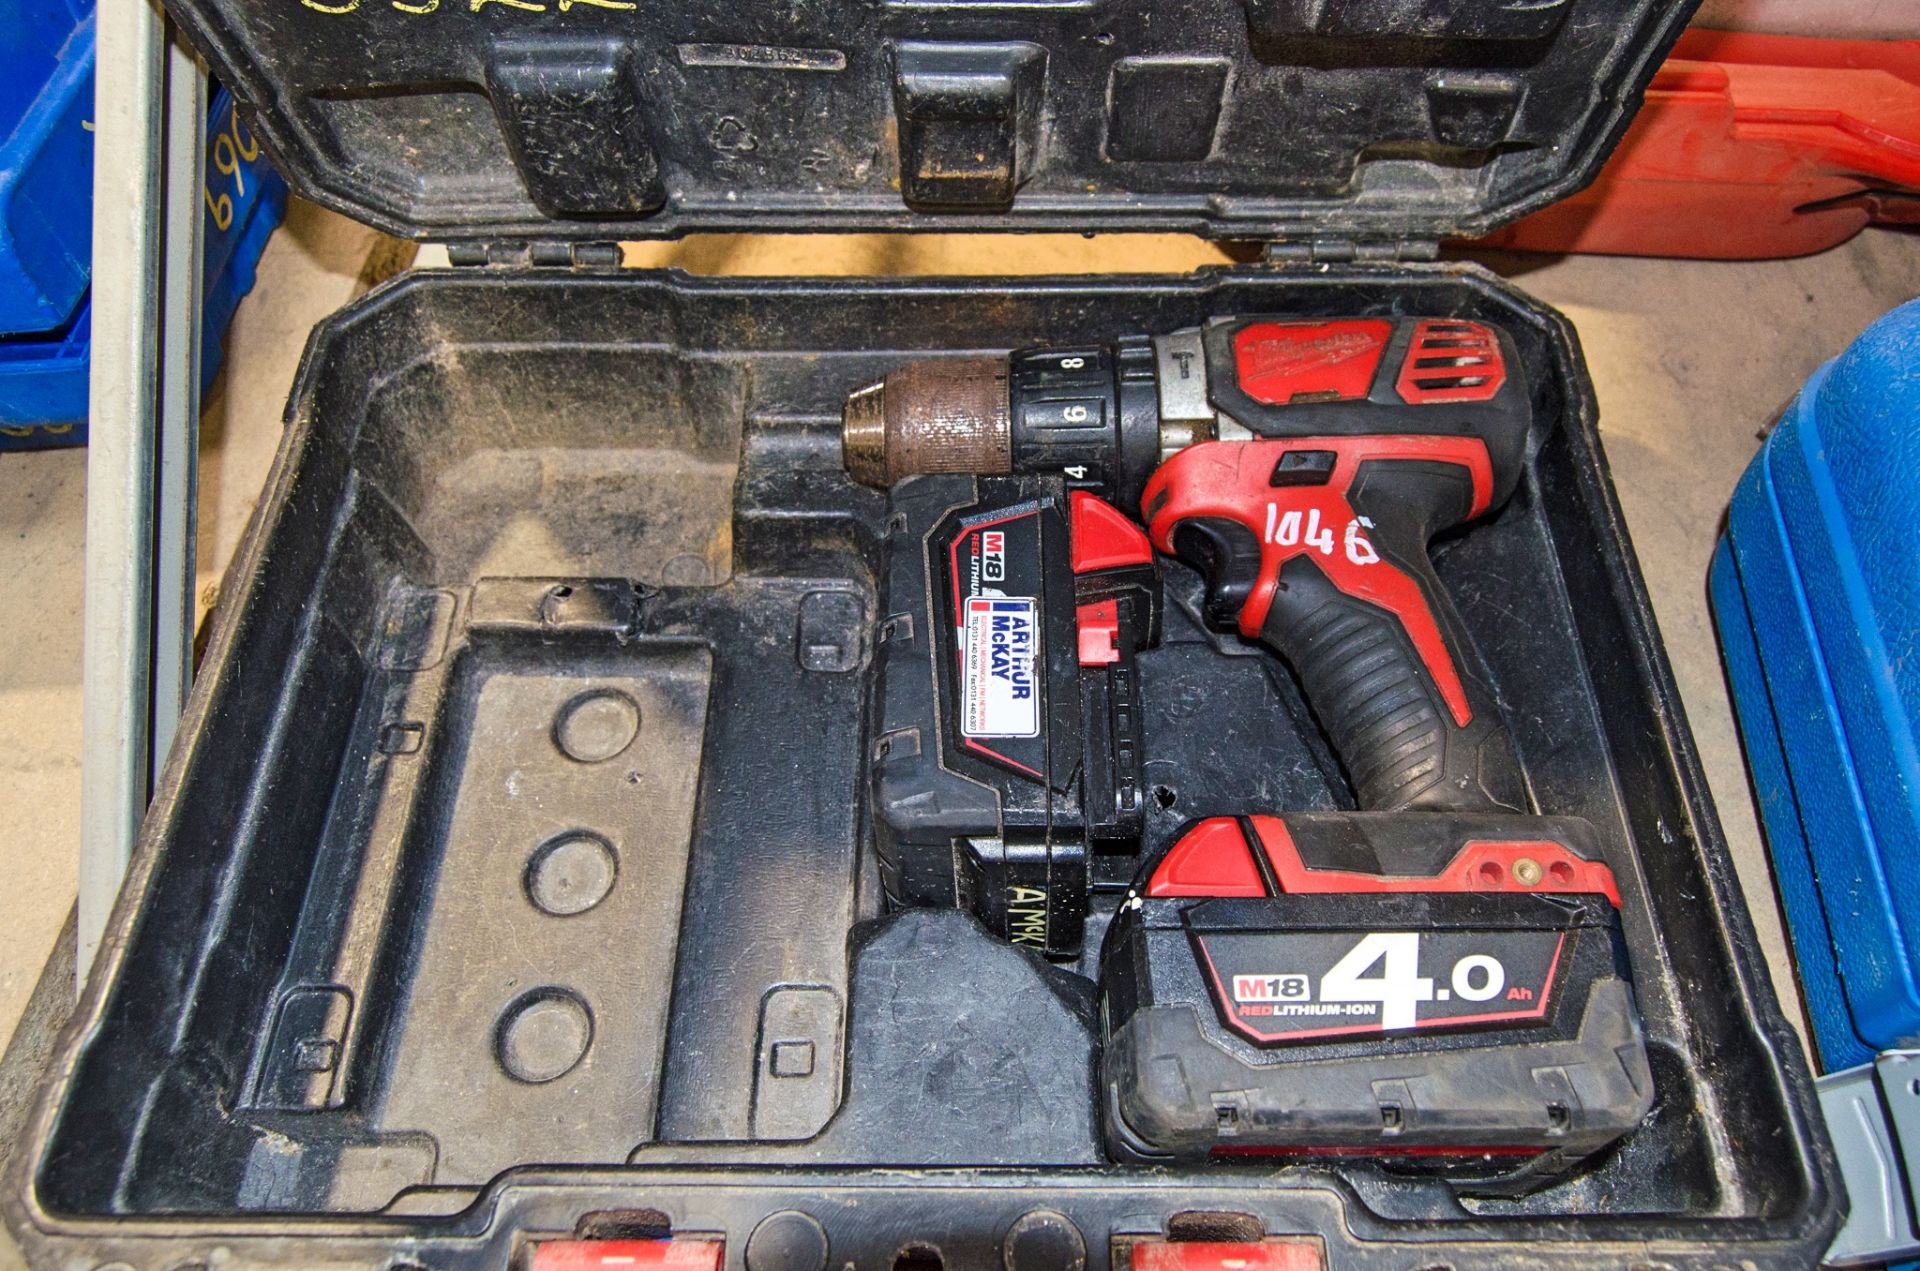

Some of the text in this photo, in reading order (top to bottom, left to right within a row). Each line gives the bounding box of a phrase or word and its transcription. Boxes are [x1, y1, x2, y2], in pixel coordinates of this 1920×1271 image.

[1060, 357, 1084, 368] 8
[1063, 405, 1087, 422] 6
[1064, 465, 1088, 479] 4
[985, 533, 1003, 579] M18
[1265, 502, 1380, 565] 1046
[991, 615, 1010, 681] McKAY
[1012, 616, 1030, 700] ARTHUR
[1238, 932, 1533, 1030] M18 4.0 Ah
[1238, 1003, 1376, 1017] REDLITHIUM-ION
